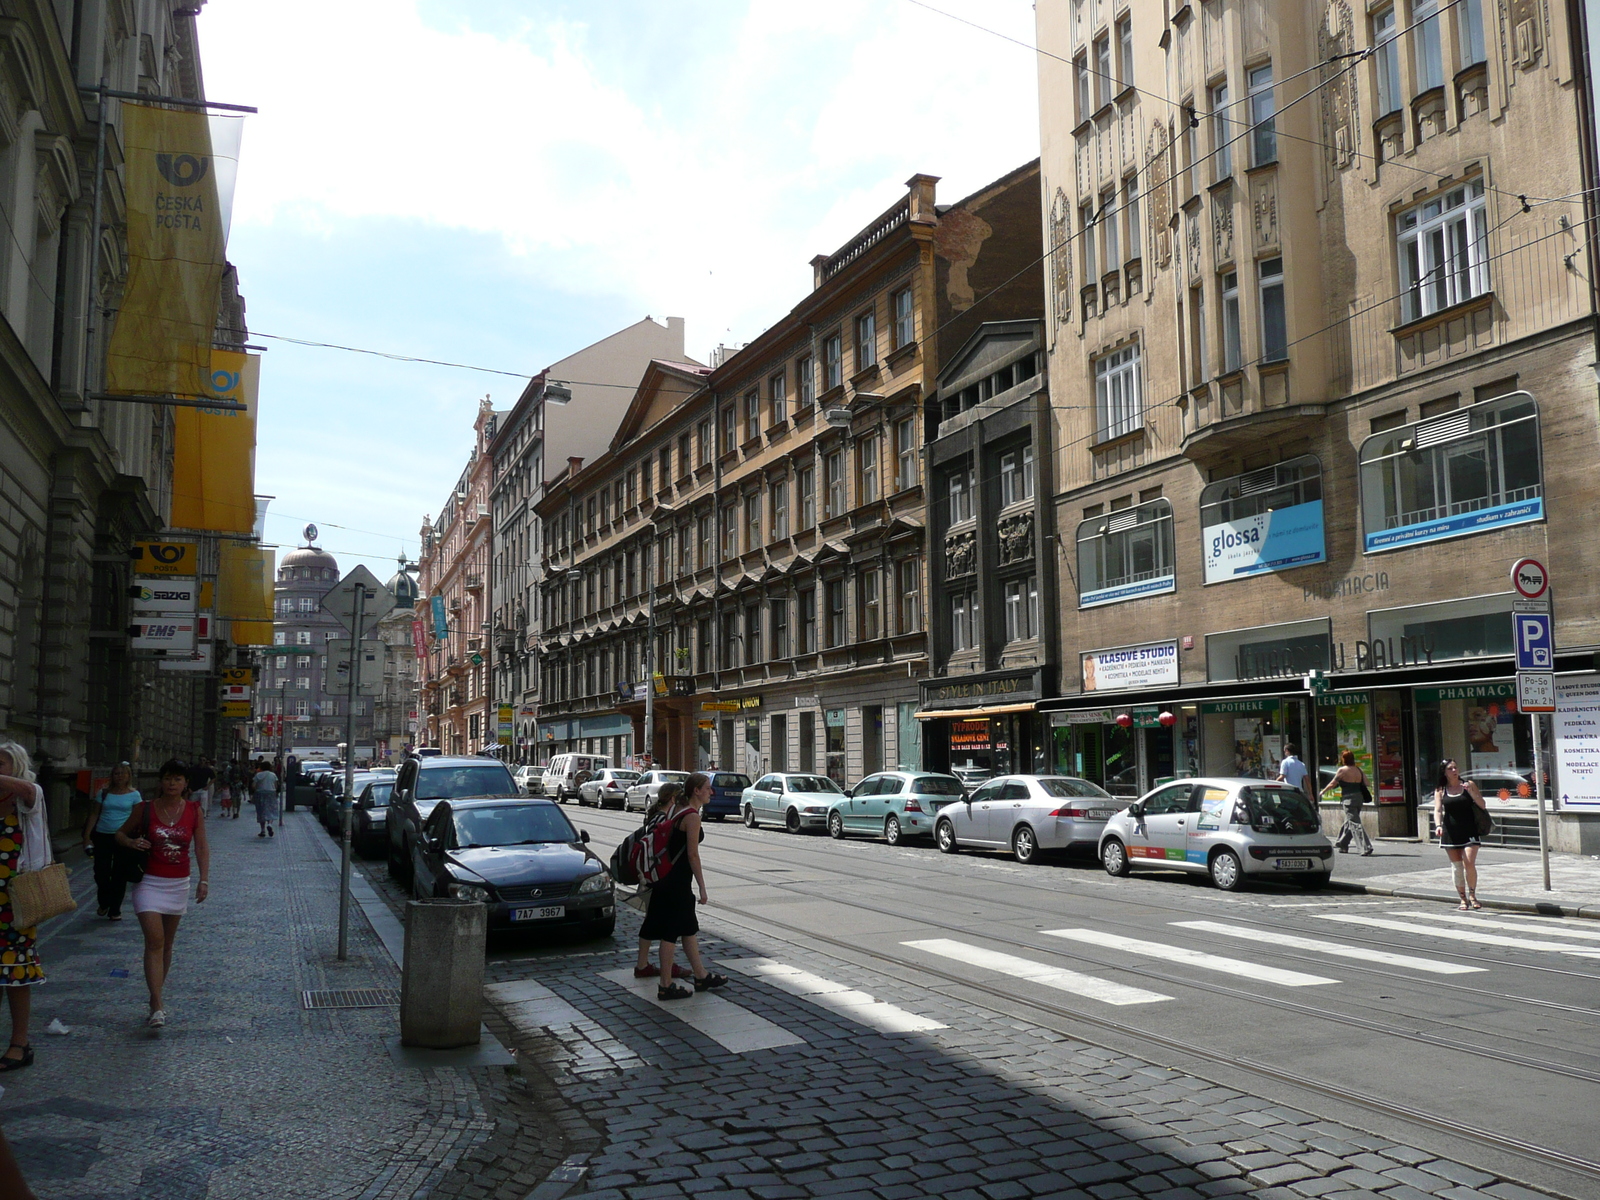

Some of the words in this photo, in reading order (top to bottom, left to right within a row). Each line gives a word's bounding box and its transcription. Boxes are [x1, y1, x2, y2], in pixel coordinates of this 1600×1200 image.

[155, 191, 203, 213] ČESKÁ
[156, 211, 202, 231] POŠTA
[1476, 513, 1499, 524] studium
[1213, 527, 1260, 558] glossa
[153, 564, 178, 572] POŠTA
[147, 625, 177, 637] EMS
[1522, 620, 1544, 652] P
[1098, 648, 1138, 664] VLASOVÉ
[1139, 645, 1175, 660] STUDIO
[1355, 631, 1435, 672] PALMY
[1524, 676, 1548, 686] Po-So
[939, 683, 969, 699] STYLE
[973, 682, 984, 696] IN
[988, 678, 1019, 695] ITALY
[1438, 685, 1515, 699] PHARMACY
[1214, 701, 1264, 713] APOTHEKE
[1542, 697, 1547, 705] 2
[1548, 697, 1554, 705] h
[517, 909, 534, 920] 7A7
[539, 907, 561, 918] 3967
